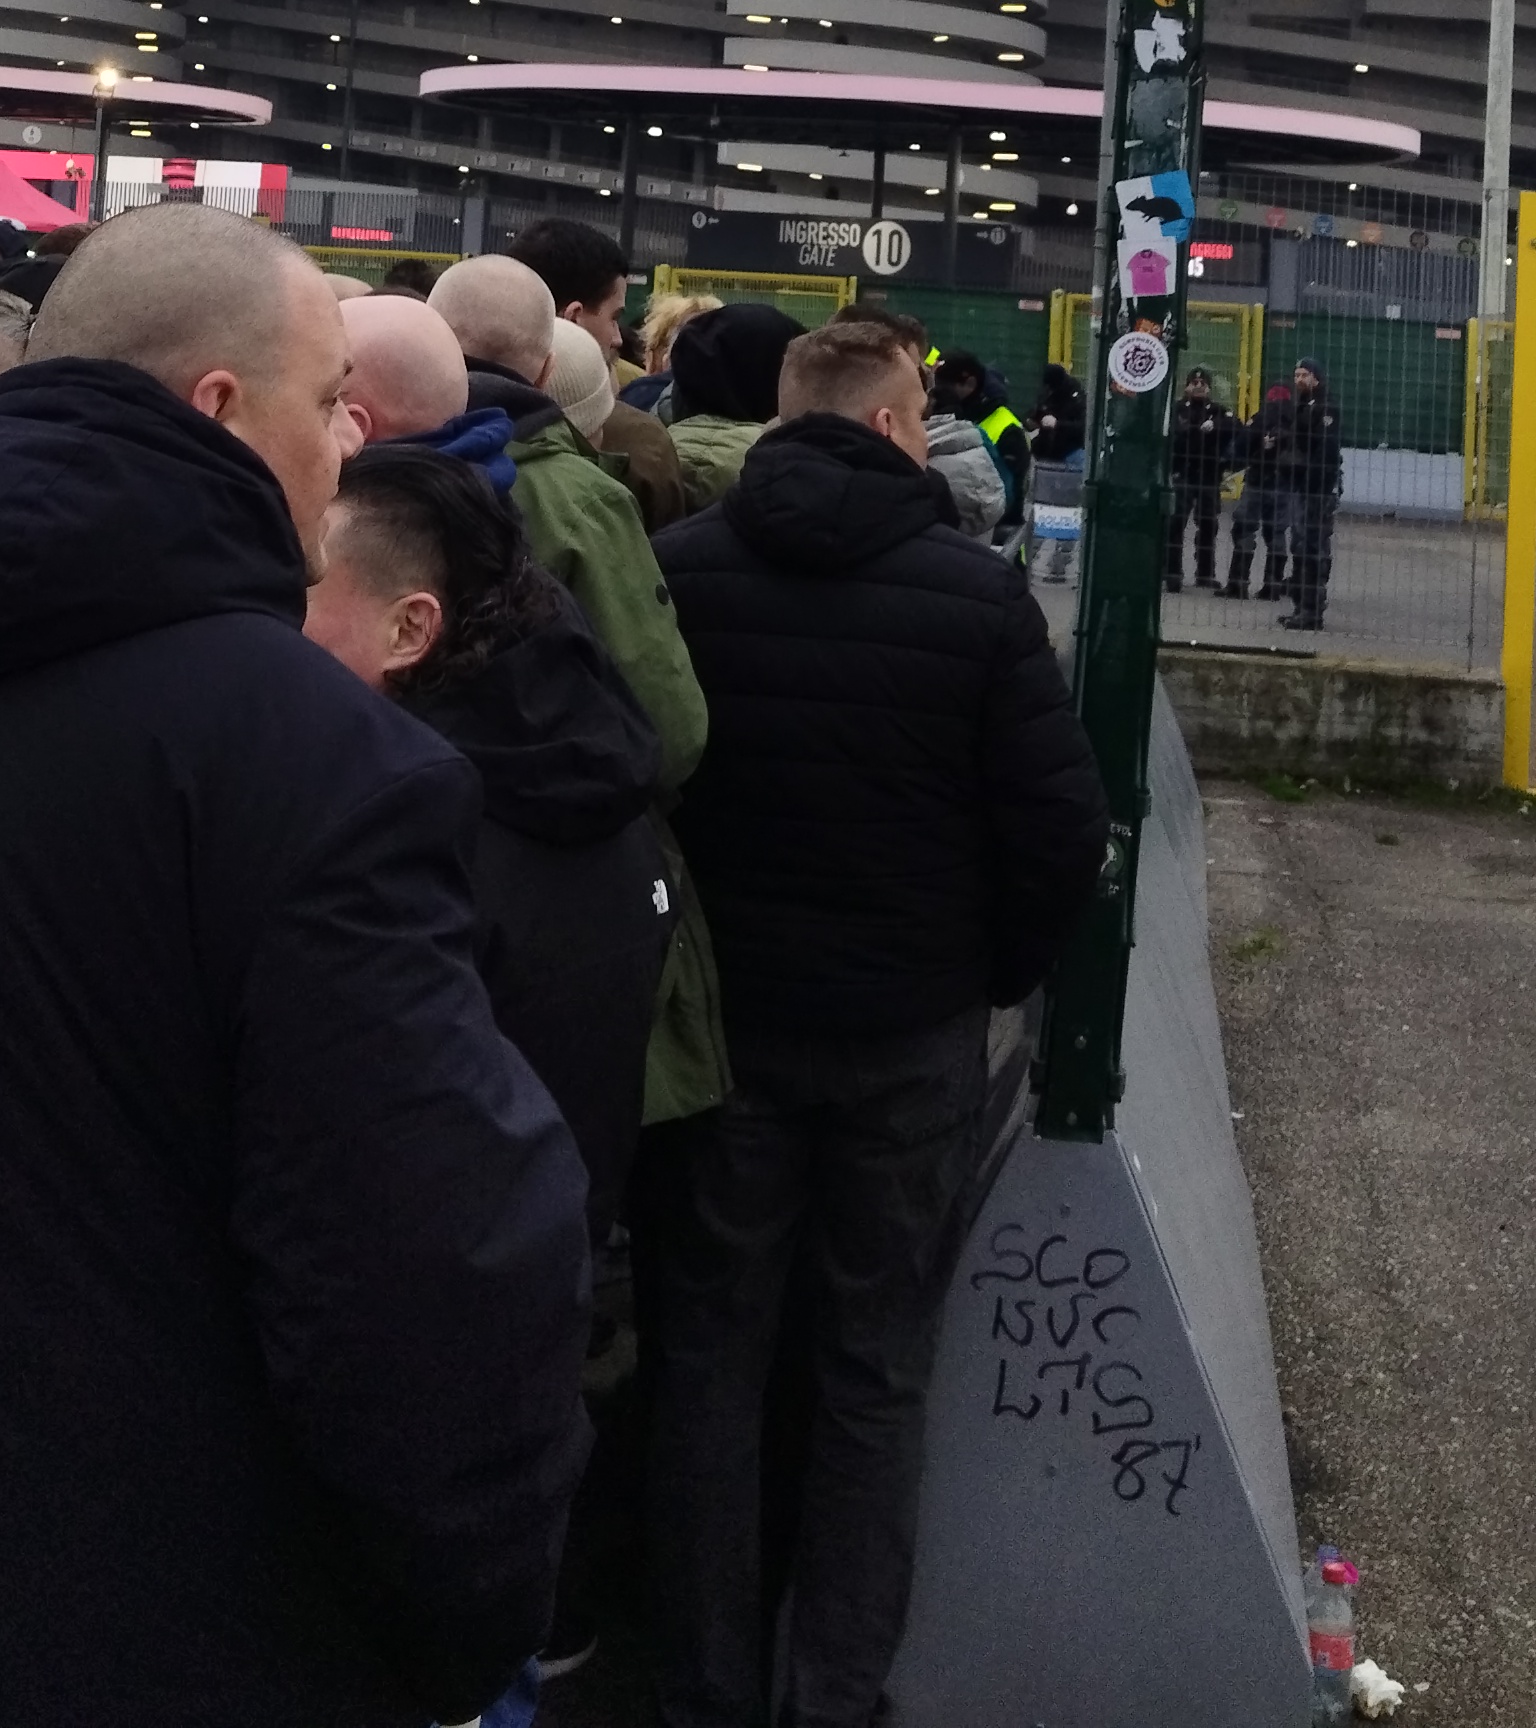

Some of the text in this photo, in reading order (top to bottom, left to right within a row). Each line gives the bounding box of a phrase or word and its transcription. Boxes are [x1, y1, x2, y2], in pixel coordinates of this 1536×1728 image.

[778, 220, 861, 248] INGRESSO
[872, 228, 904, 267] 10
[798, 243, 839, 267] GATE
